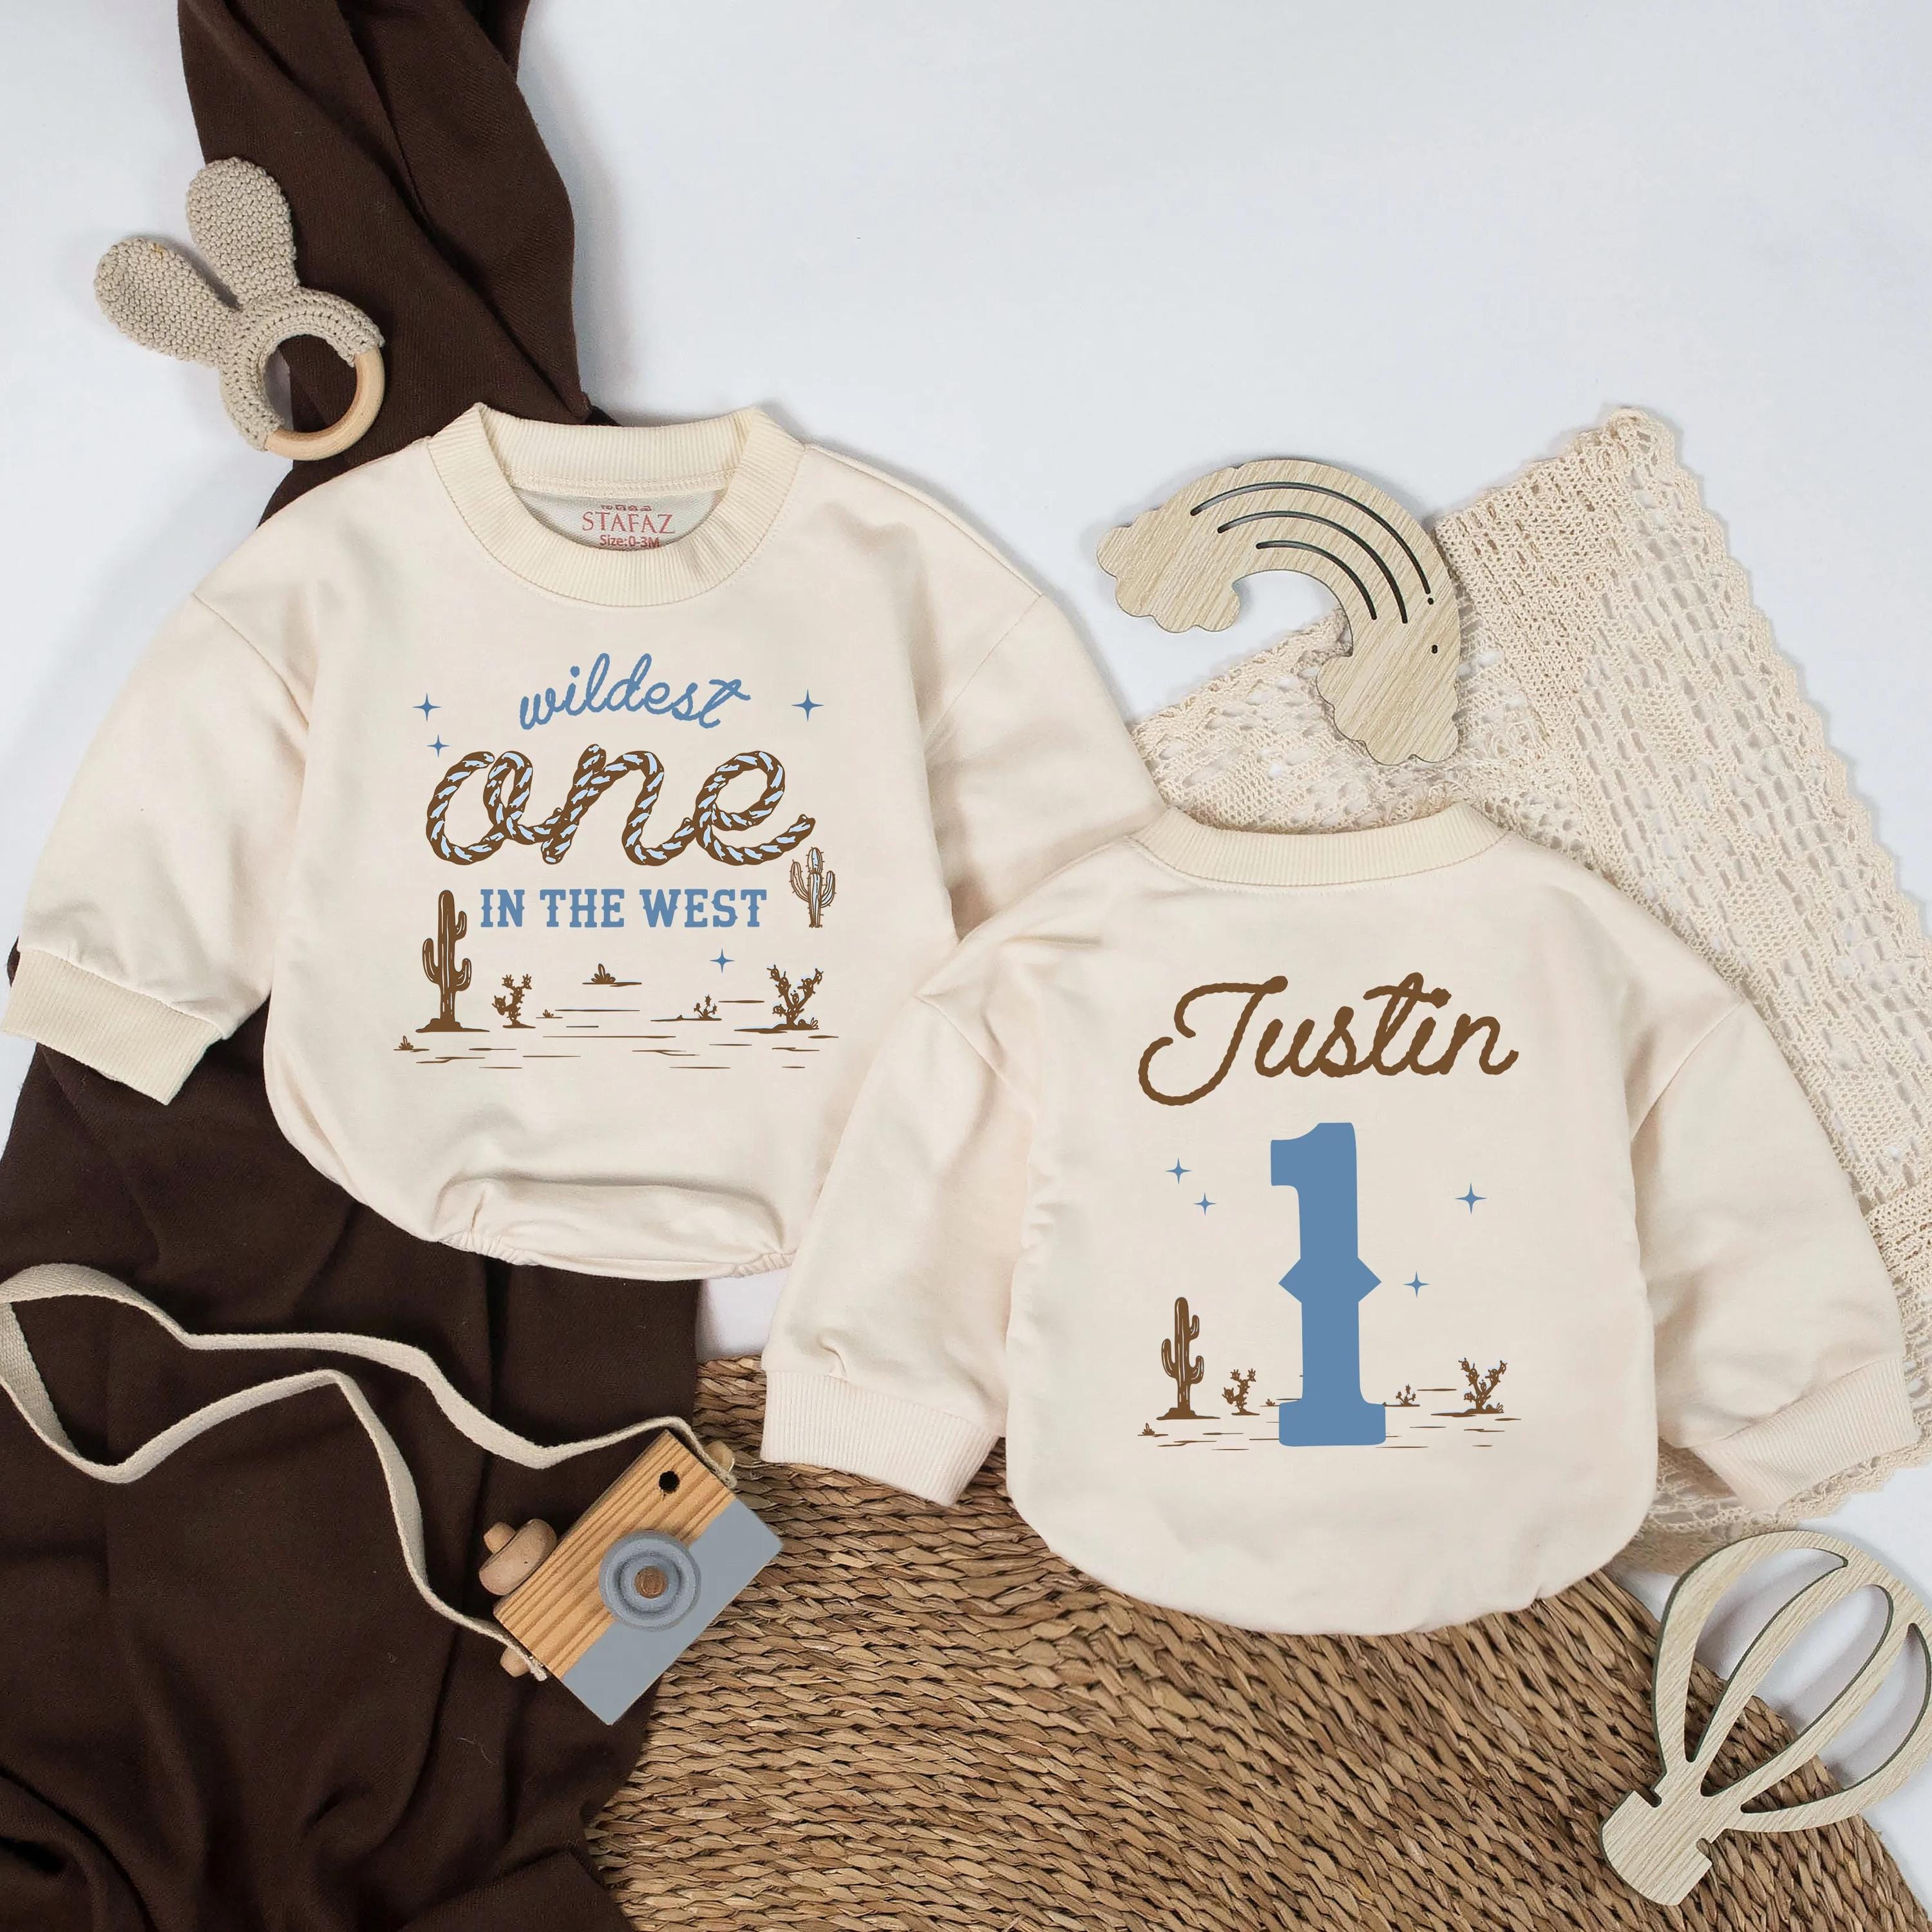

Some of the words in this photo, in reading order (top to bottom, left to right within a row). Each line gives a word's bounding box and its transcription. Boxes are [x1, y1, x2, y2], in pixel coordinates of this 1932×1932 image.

[582, 511, 675, 534] STAFAZ
[520, 652, 750, 730] wildest
[426, 744, 815, 866] one
[480, 889, 525, 928] IN
[540, 889, 625, 928] THE
[639, 889, 767, 928] WEST
[1138, 972, 1519, 1106] Justin
[1271, 1122, 1386, 1447] 1
